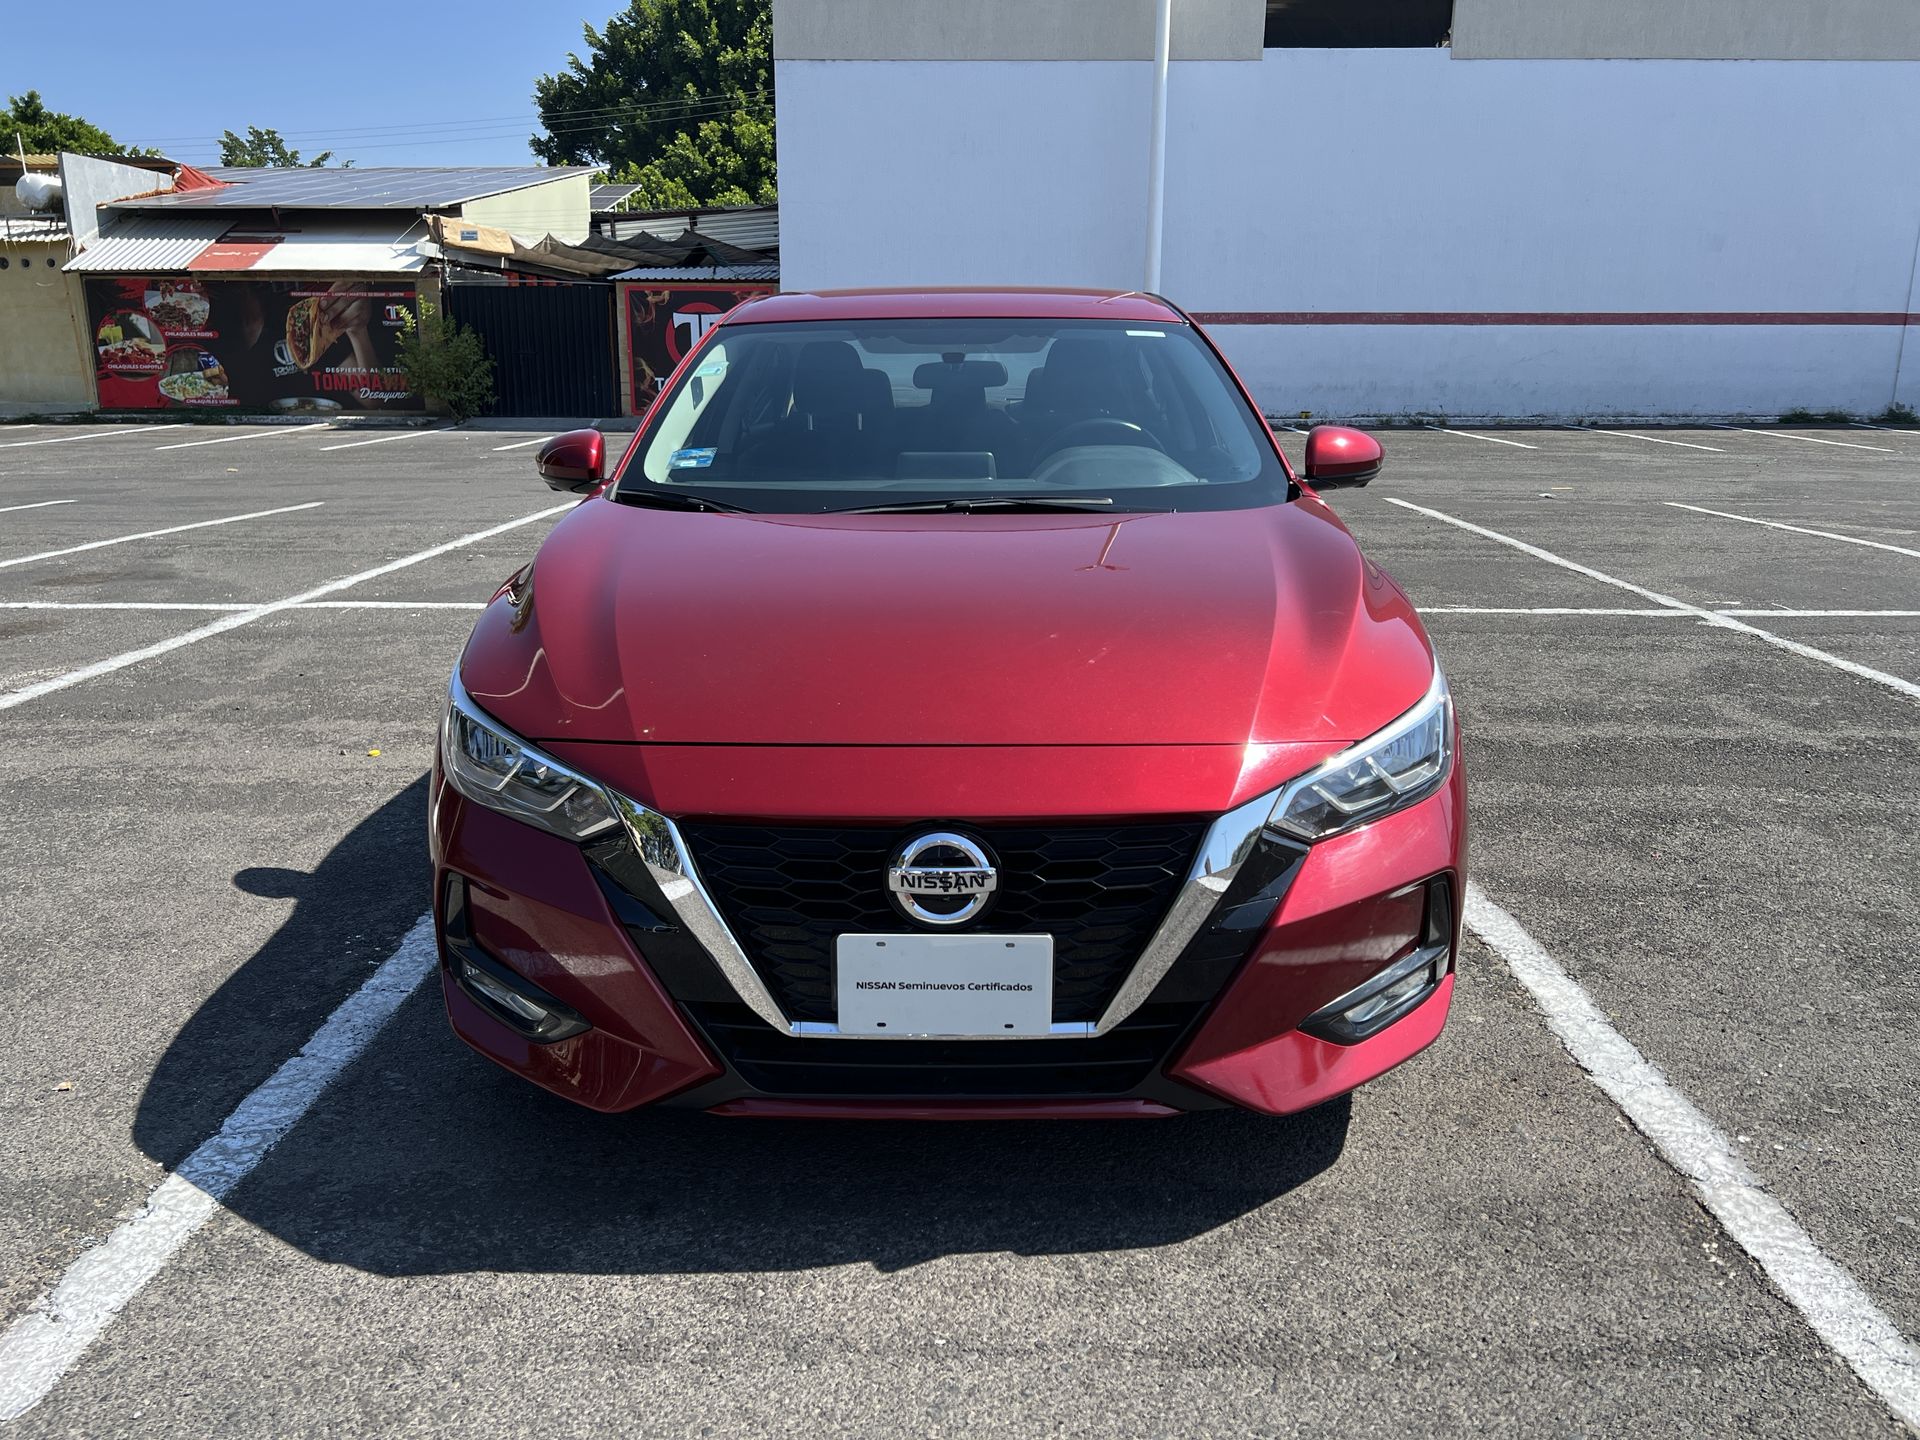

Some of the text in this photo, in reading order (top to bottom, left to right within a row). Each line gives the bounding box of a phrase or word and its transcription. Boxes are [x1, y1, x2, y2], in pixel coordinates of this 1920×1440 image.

[900, 874, 985, 889] NISSAN
[856, 981, 1033, 992] NISSAN Seminuevos Certificados
